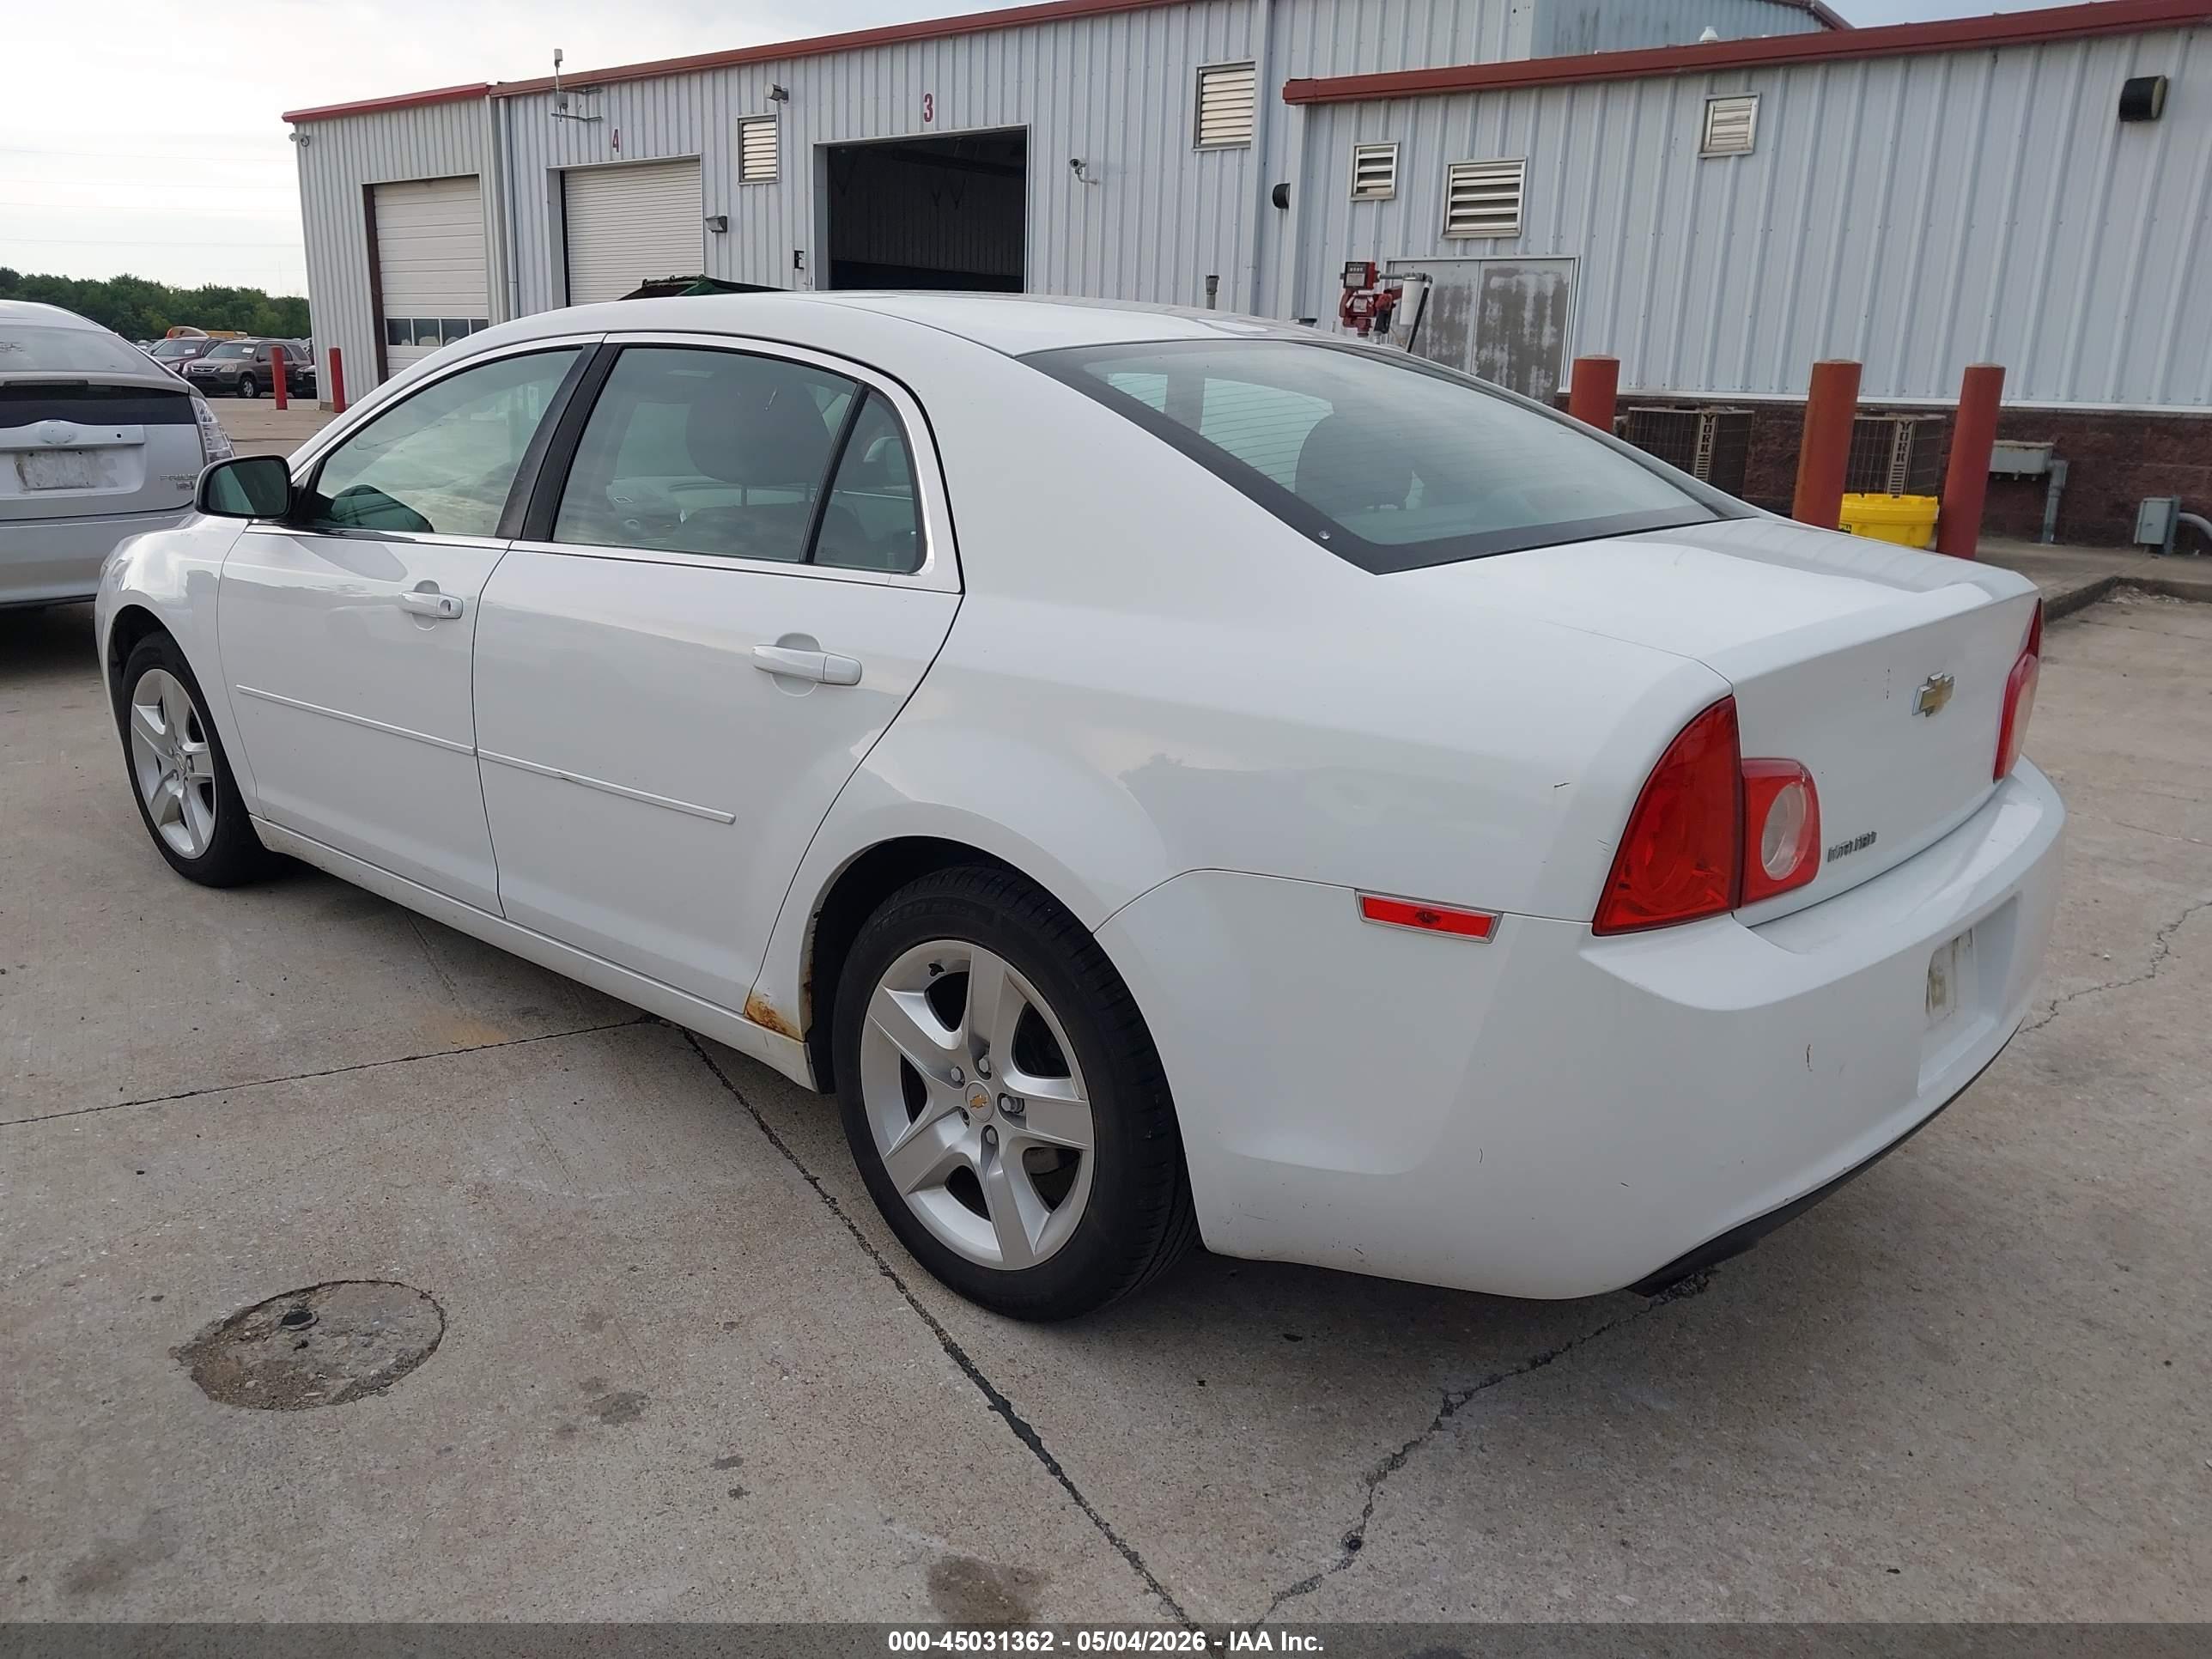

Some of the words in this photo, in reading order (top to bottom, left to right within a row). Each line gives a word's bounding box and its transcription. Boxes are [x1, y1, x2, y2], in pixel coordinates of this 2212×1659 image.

[923, 93, 933, 123] 3
[612, 129, 619, 153] 4
[1699, 414, 1716, 453] YORK
[1895, 421, 1912, 462] YORK
